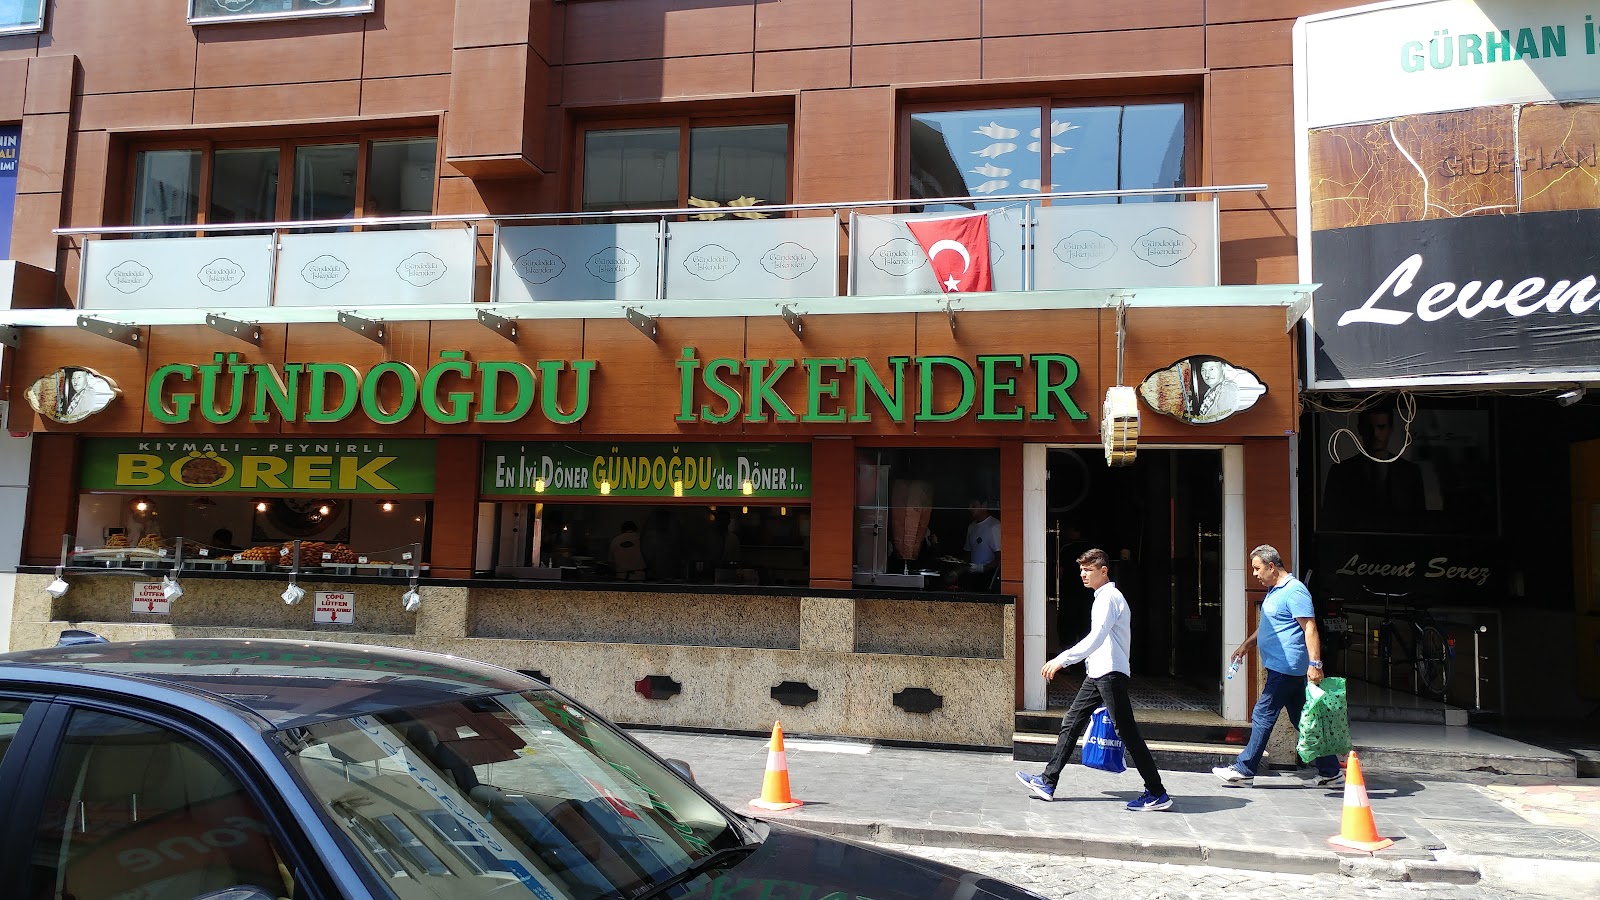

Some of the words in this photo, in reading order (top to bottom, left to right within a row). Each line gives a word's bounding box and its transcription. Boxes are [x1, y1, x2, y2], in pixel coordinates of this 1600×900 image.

[1401, 27, 1567, 73] GÜRHAN
[1585, 15, 1600, 54] İ
[1337, 253, 1600, 327] Leven
[147, 351, 597, 425] GÜNDOĞDU
[675, 346, 1089, 425] İSKENDER
[138, 442, 240, 452] KIYMALI
[268, 442, 384, 453] PEYNİRLİ
[115, 451, 400, 490] BÖREK
[1335, 554, 1416, 577] Levent
[1424, 557, 1491, 586] Serez
[325, 593, 345, 601] ÇÖPÜ
